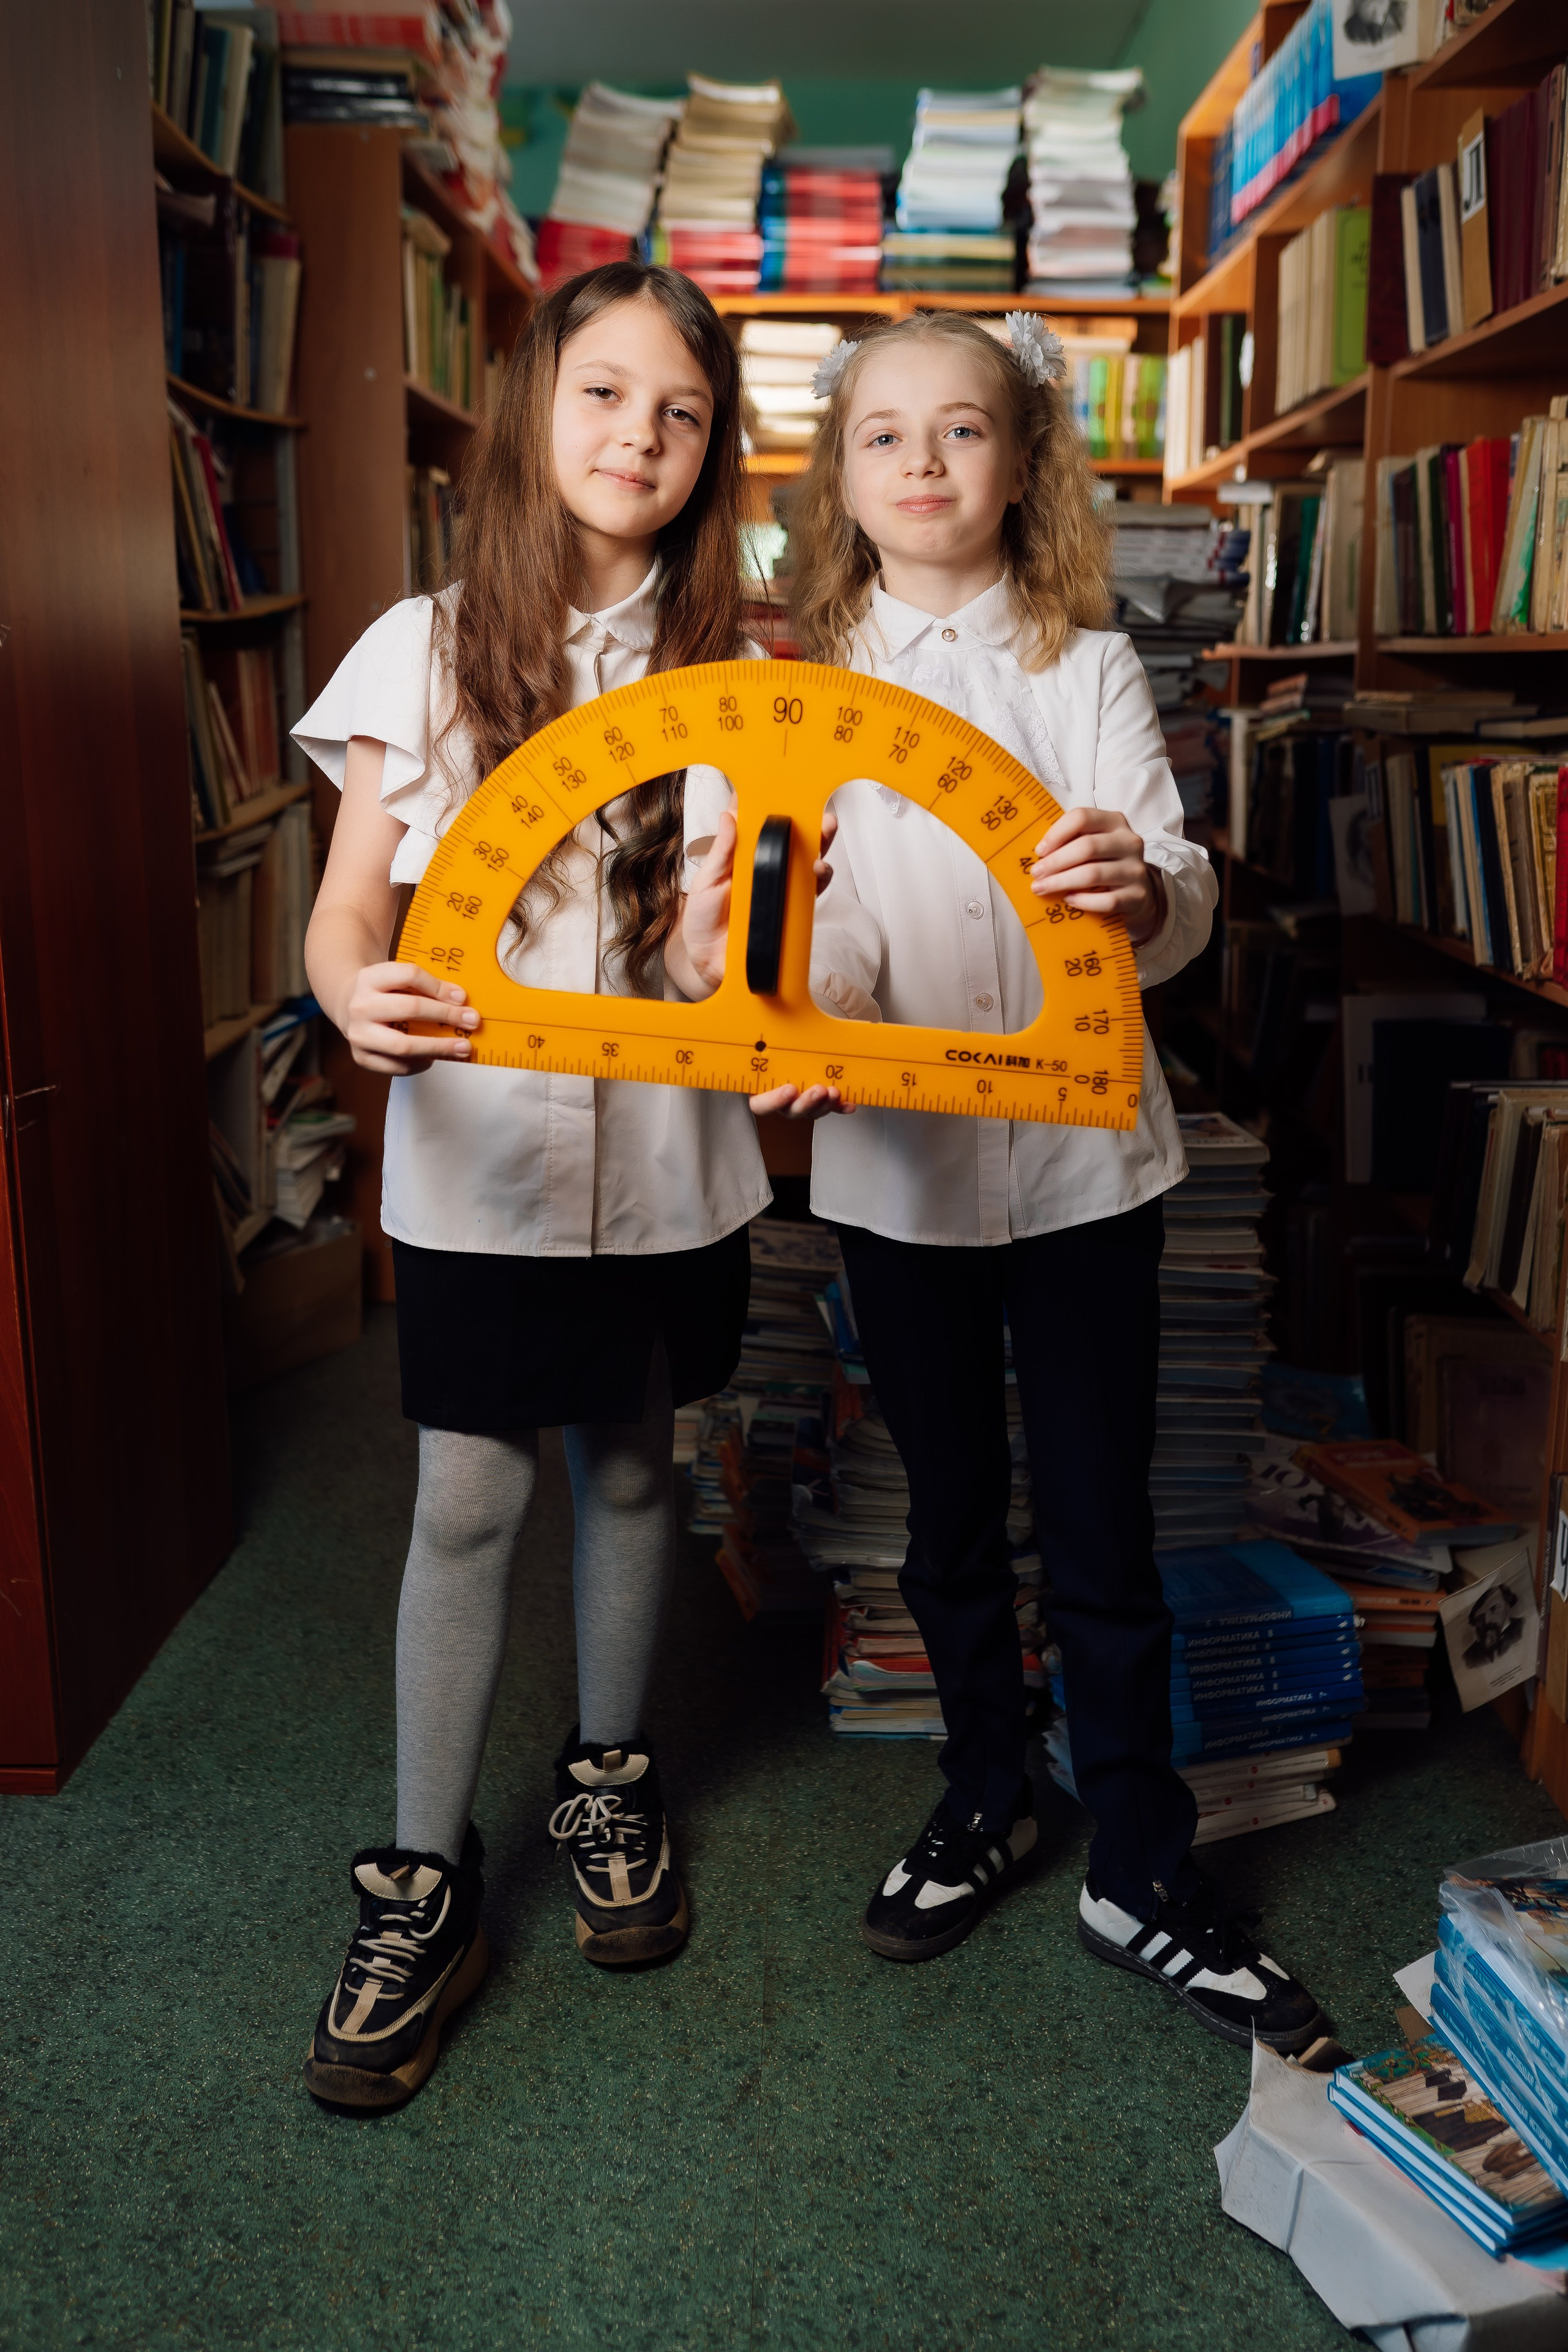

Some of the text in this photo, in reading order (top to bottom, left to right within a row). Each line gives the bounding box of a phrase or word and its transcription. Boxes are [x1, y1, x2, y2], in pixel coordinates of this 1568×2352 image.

[719, 696, 737, 712] 80
[774, 697, 803, 725] 90
[660, 706, 678, 722] 70
[718, 715, 743, 731] 100
[837, 707, 862, 726] 100
[604, 727, 622, 743] 60
[662, 723, 687, 741] 110
[834, 726, 853, 743] 80
[894, 727, 919, 748] 110
[609, 742, 635, 762] 120
[890, 745, 907, 764] 70
[553, 757, 572, 775] 50
[947, 757, 972, 780] 120
[562, 770, 586, 791] 130
[938, 773, 957, 793] 60
[511, 796, 528, 813] 40
[993, 795, 1018, 821] 130
[520, 805, 544, 828] 140
[981, 810, 1002, 831] 50
[474, 841, 492, 860] 30
[488, 848, 509, 872] 150
[447, 892, 464, 911] 20
[462, 896, 482, 919] 160
[1046, 904, 1065, 924] 30
[431, 948, 446, 962] 10
[447, 948, 464, 971] 170
[1082, 950, 1102, 976] 160
[1065, 958, 1083, 976] 20
[1074, 1015, 1090, 1031] 10
[1093, 1009, 1109, 1035] 170
[528, 1035, 545, 1049] 40
[602, 1042, 619, 1057] 35
[676, 1050, 693, 1065] 30
[751, 1057, 769, 1072] 25
[1036, 1059, 1068, 1072] K-50
[826, 1065, 843, 1079] 20
[902, 1072, 917, 1087] 15
[1074, 1075, 1090, 1084] 0
[977, 1079, 993, 1094] 10
[1091, 1070, 1109, 1095] 180
[1058, 1087, 1067, 1103] 5
[1128, 1094, 1137, 1107] 0
[1188, 1630, 1260, 1648] ИНФОРМАТИКА
[1189, 1657, 1262, 1675] ИНФОРМАТИКА
[1192, 1672, 1264, 1689] ИНФОРМАТИКА
[1193, 1684, 1265, 1702] ИНФОРМАТИКА
[1256, 1692, 1313, 1707] ИНФОРМАТИКА
